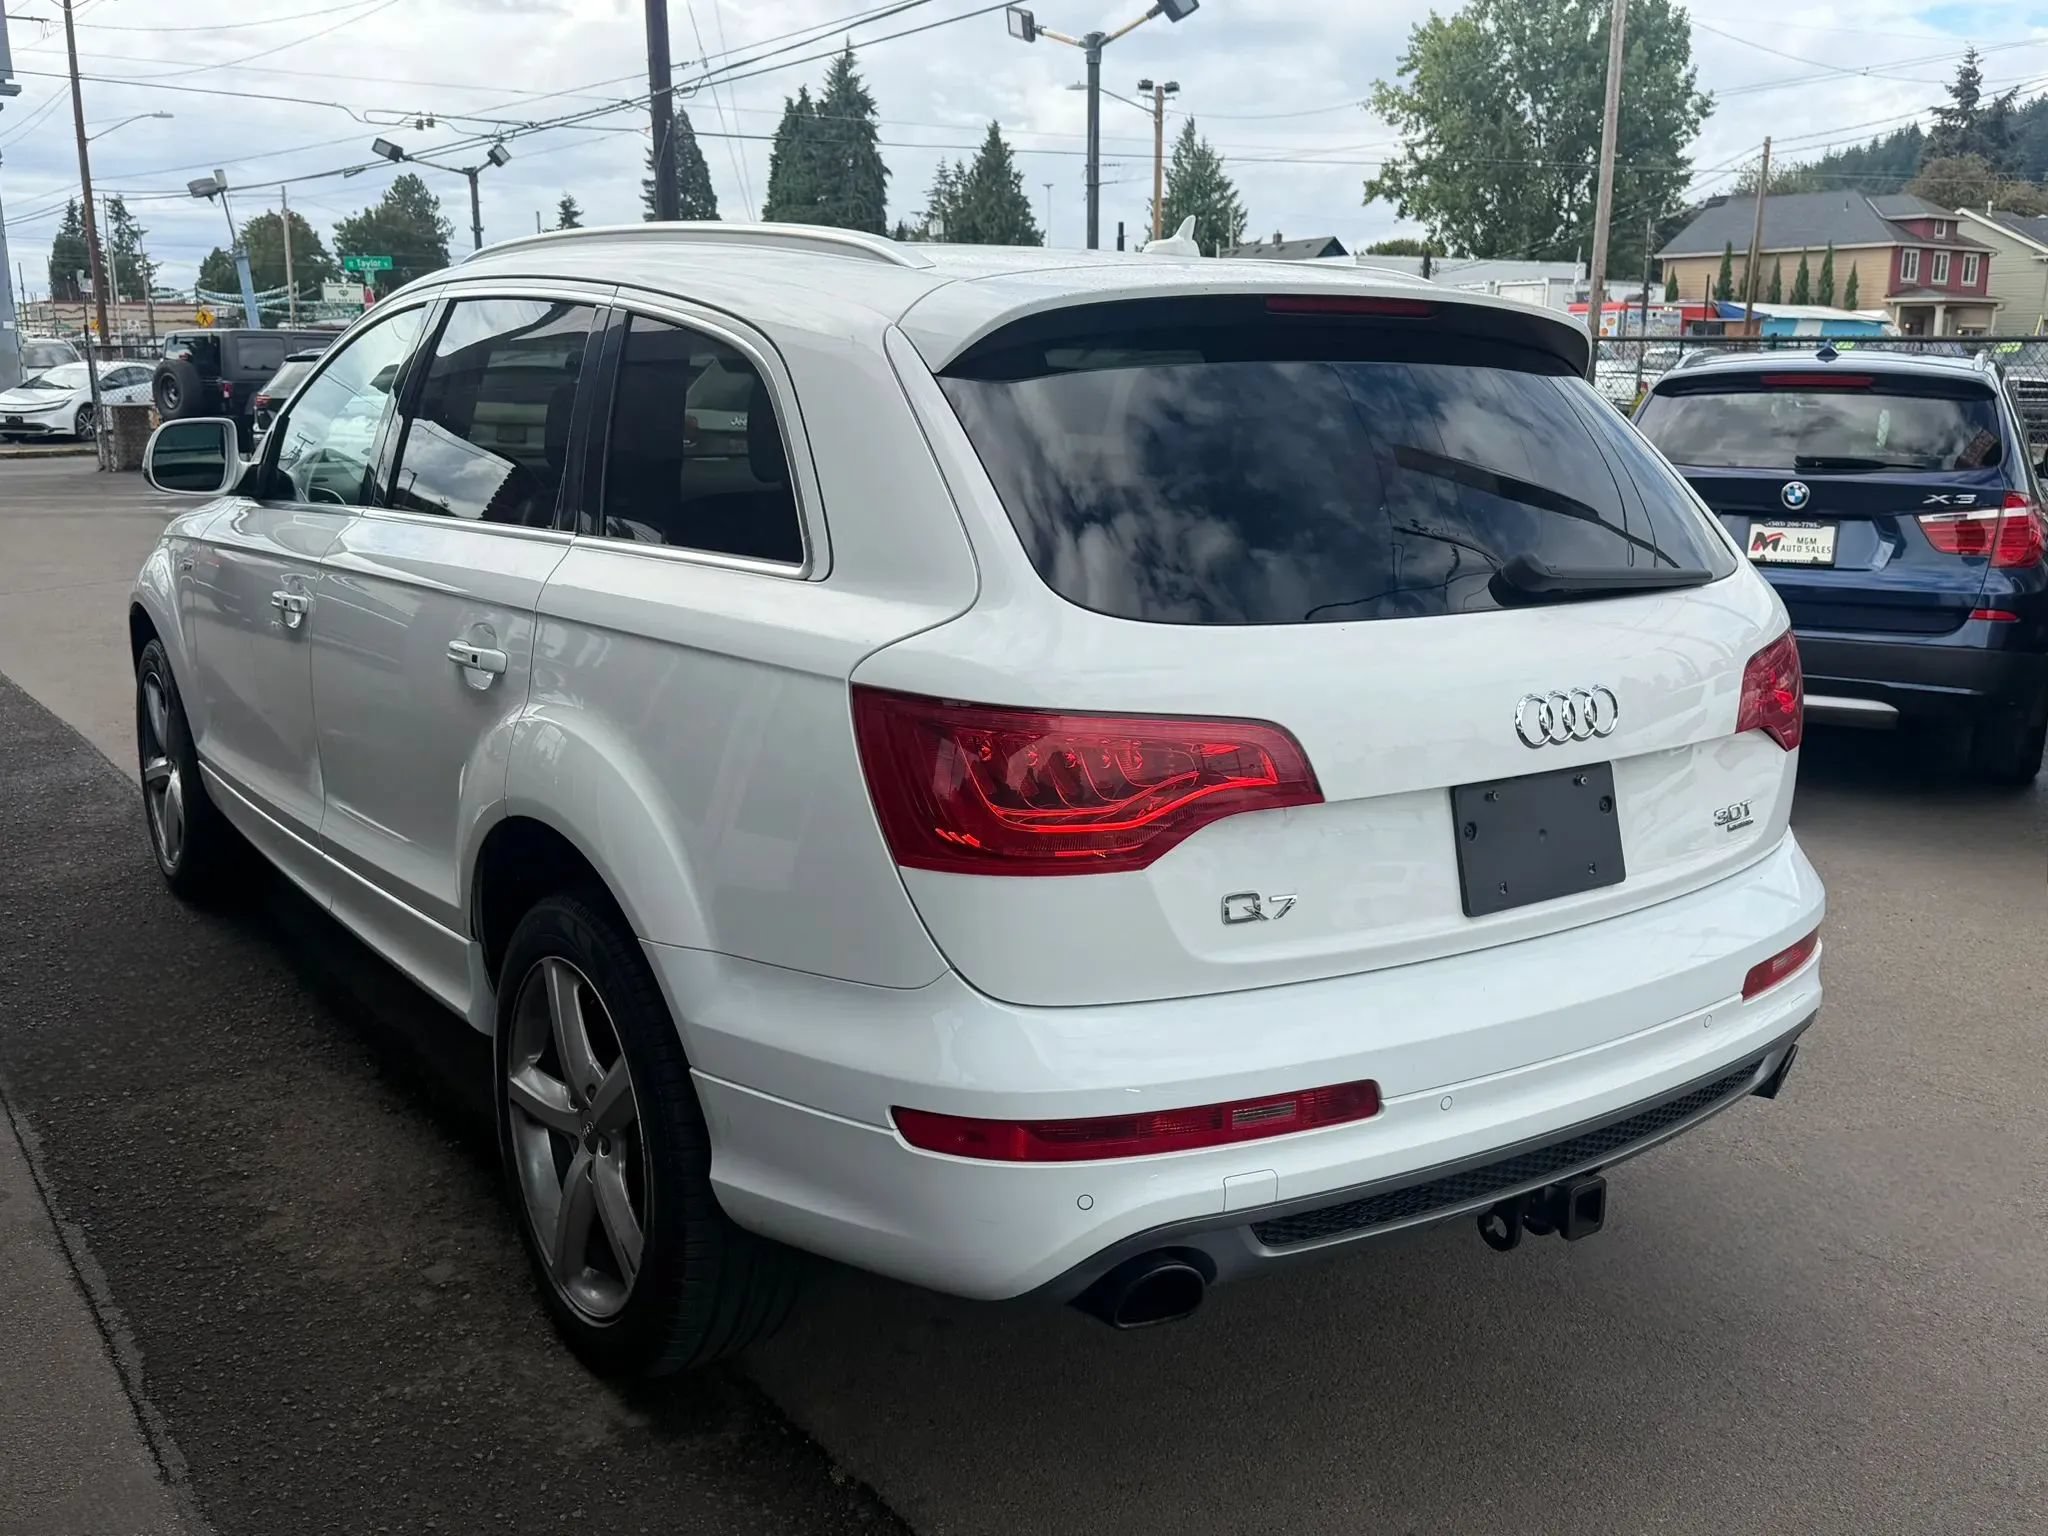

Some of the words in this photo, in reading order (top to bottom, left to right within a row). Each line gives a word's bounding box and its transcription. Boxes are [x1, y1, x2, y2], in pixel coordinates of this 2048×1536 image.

[356, 259, 381, 268] Taylor
[1922, 494, 1976, 504] X3
[1805, 546, 1831, 554] SALES
[1221, 890, 1297, 925] Q7
